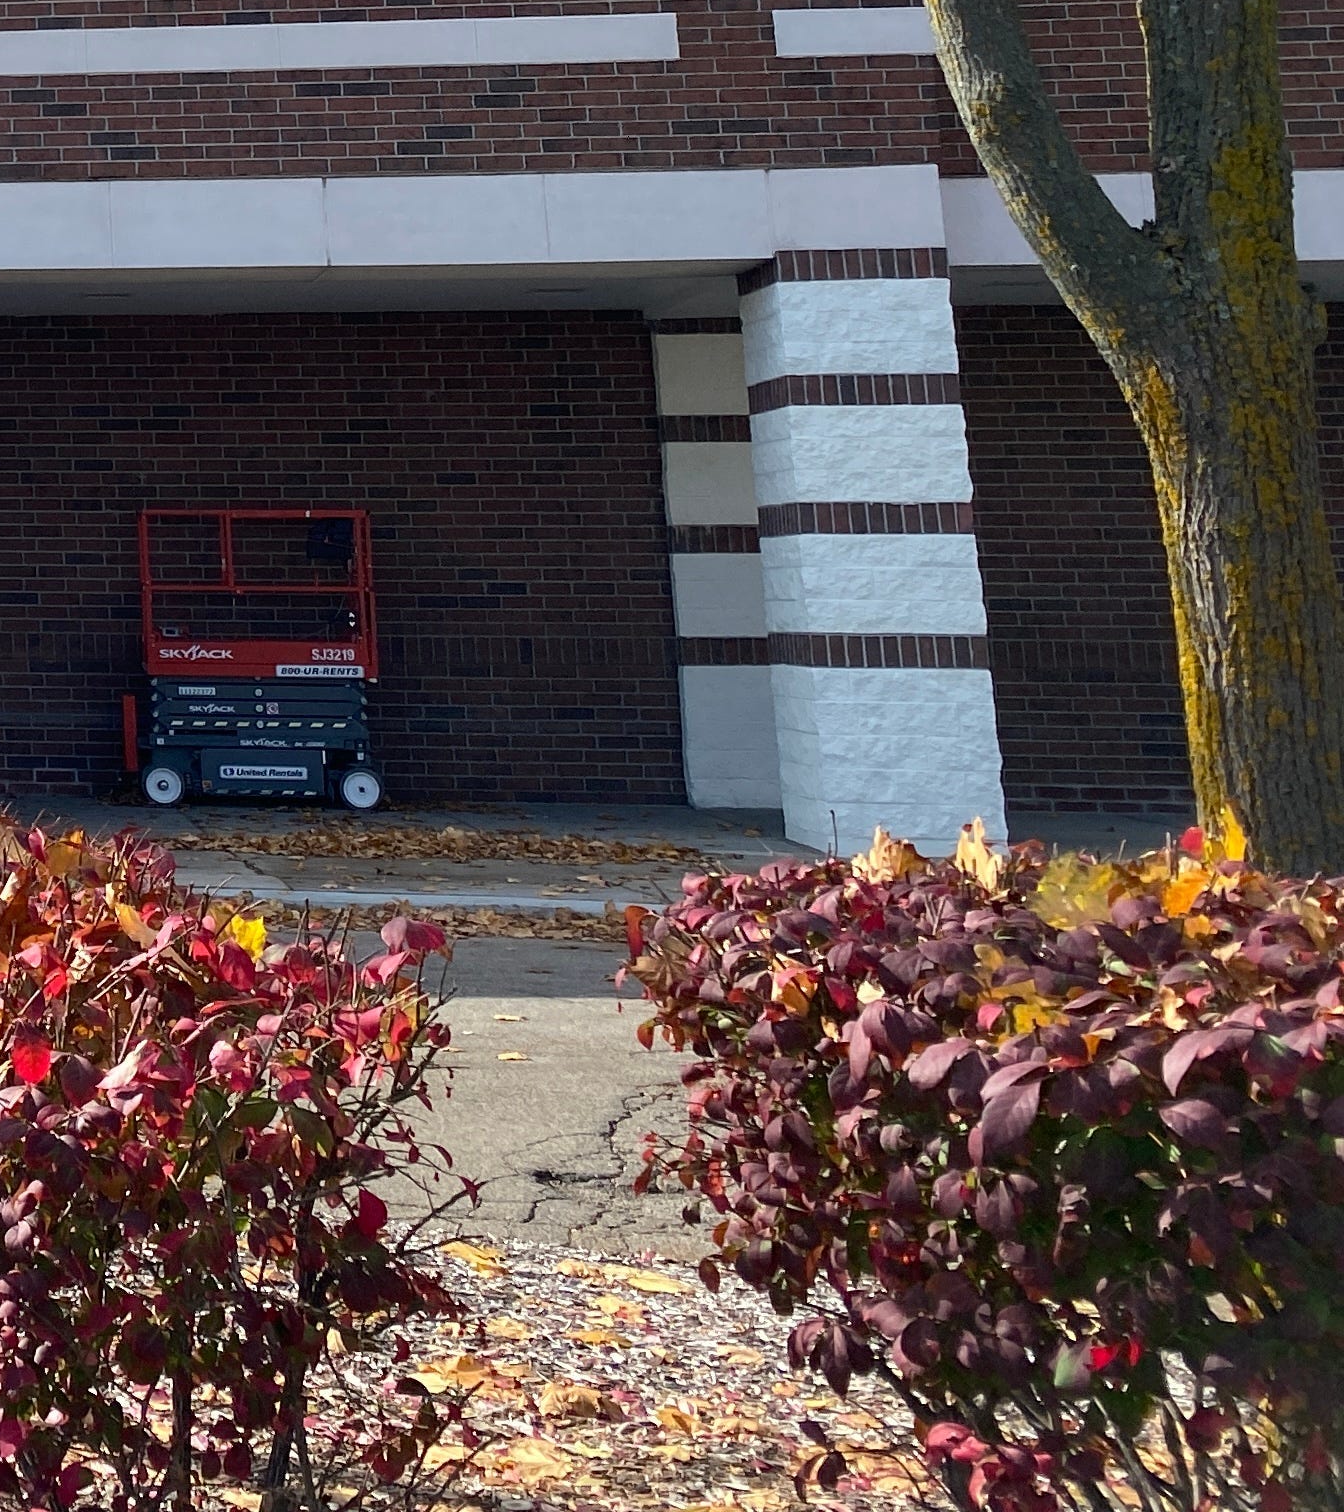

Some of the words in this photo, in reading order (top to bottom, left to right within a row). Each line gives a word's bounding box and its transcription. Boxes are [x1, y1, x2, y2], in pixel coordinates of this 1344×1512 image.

[159, 645, 234, 661] SKYJACK
[311, 648, 355, 661] SJ3219
[189, 704, 235, 713] SKYJACK
[236, 768, 267, 777] United
[268, 768, 303, 777] Rentals
